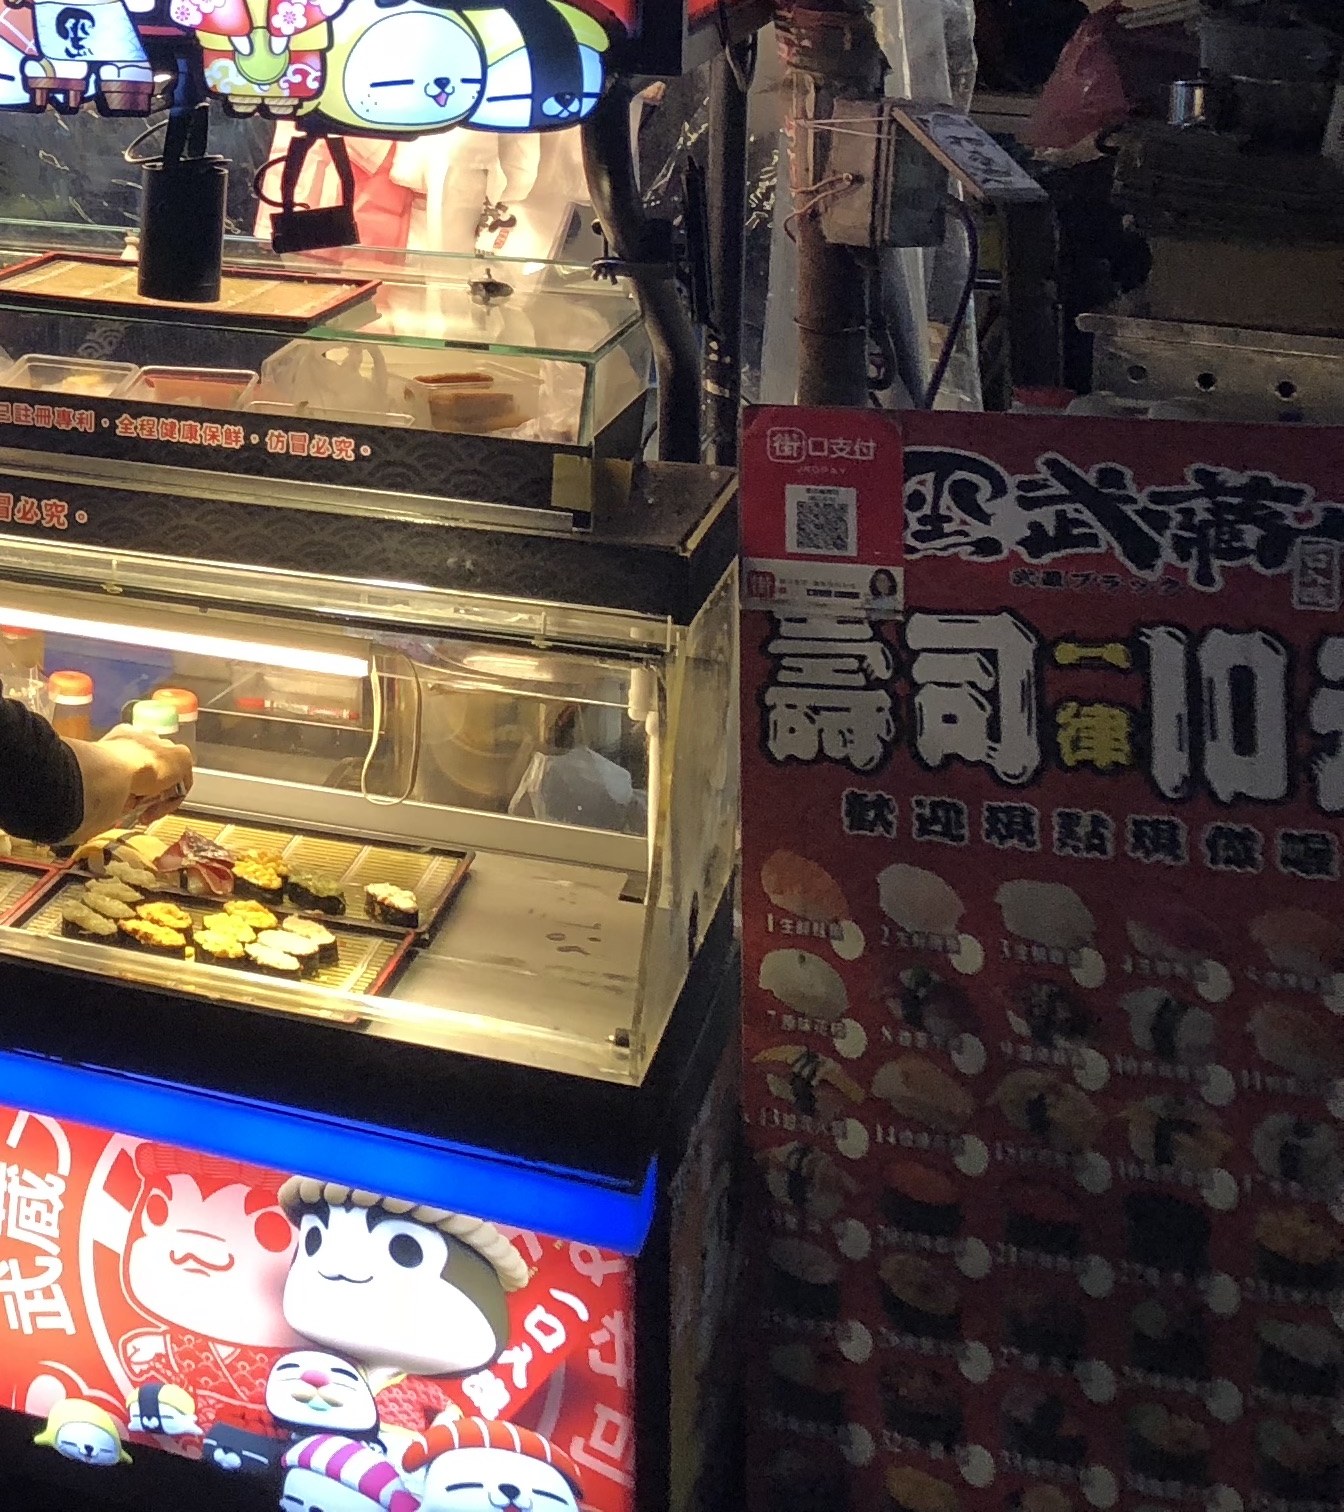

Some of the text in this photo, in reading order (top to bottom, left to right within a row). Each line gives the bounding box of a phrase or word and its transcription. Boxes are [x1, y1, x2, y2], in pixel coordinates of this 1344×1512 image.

[767, 427, 877, 463] 街口支付
[765, 610, 1041, 784] 壽司
